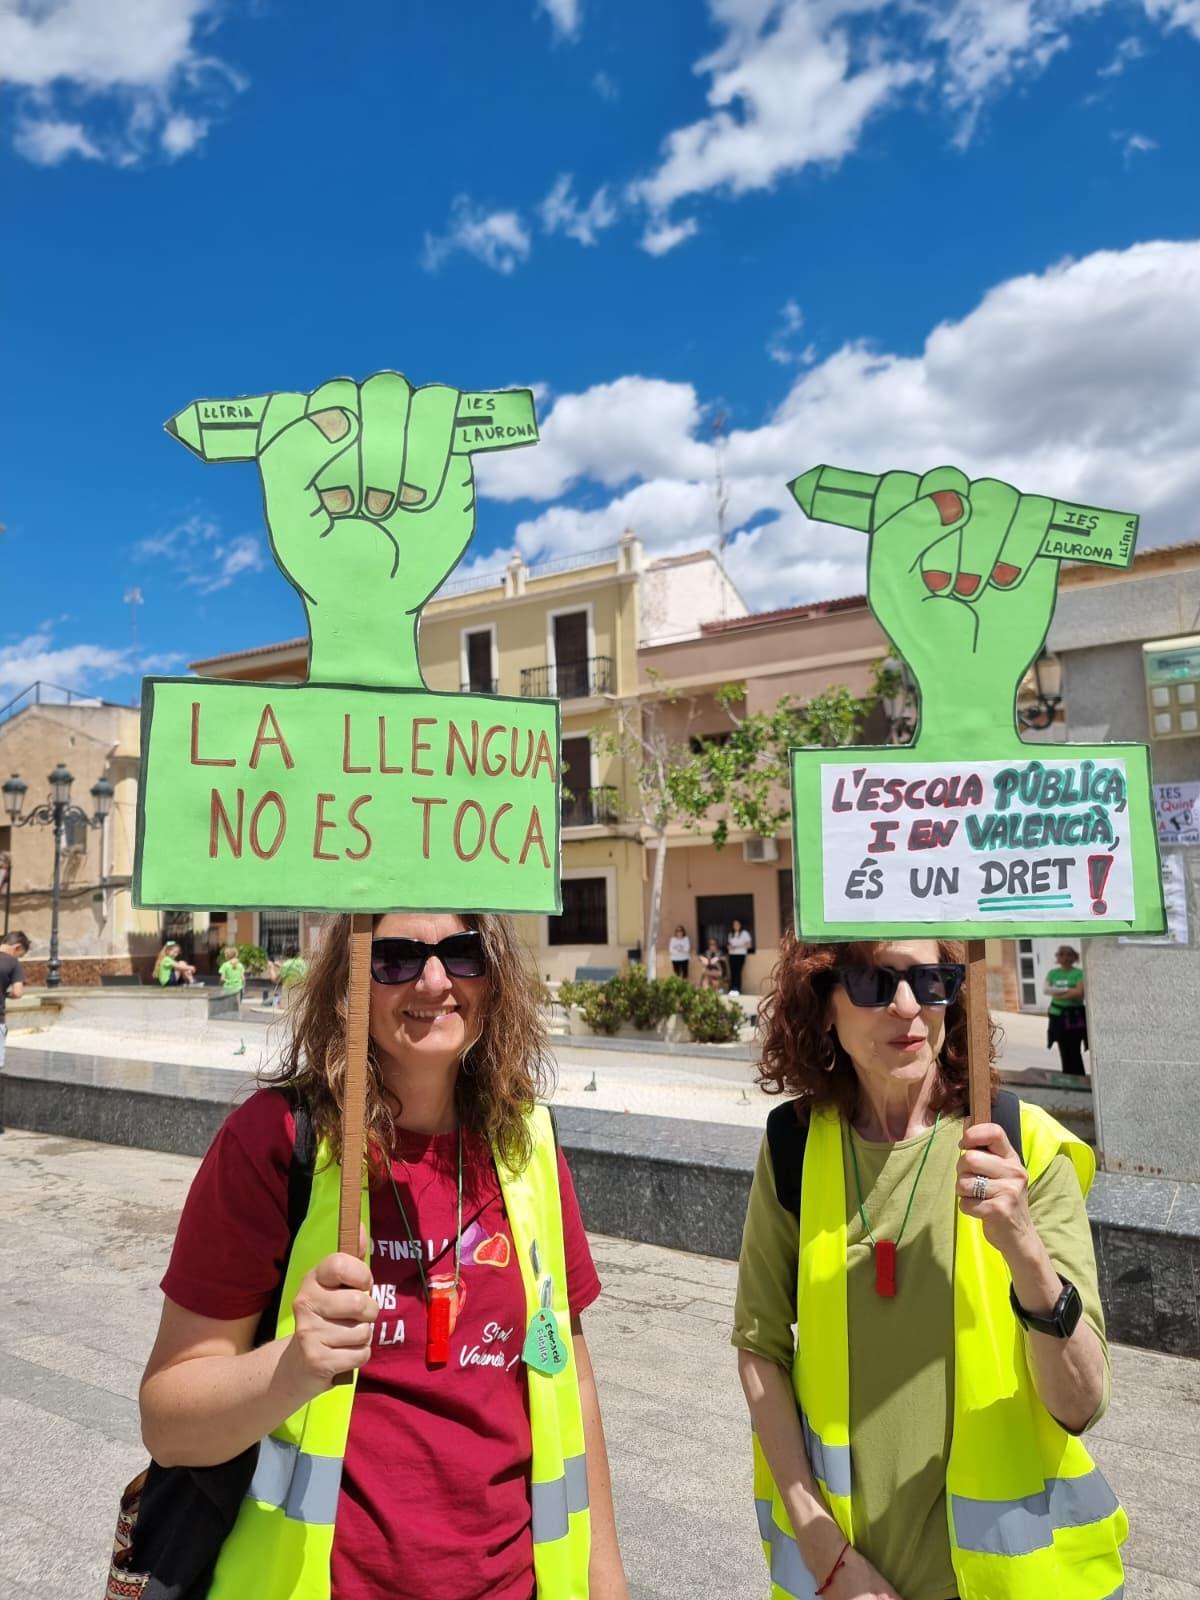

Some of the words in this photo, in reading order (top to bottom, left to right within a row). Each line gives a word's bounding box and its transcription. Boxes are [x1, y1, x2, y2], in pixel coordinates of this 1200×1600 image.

[467, 398, 496, 411] IES
[463, 424, 536, 442] LAURONA
[1063, 511, 1099, 530] IES
[1044, 540, 1113, 560] LAURONA
[190, 702, 295, 769] LA
[342, 713, 556, 783] LLENGUA
[832, 767, 983, 813] L'ESCOLA
[1159, 786, 1181, 800] IES
[209, 788, 288, 860] NO
[313, 794, 372, 860] ES
[412, 796, 551, 868] TOCA
[867, 820, 900, 853] I
[907, 818, 959, 851] EN
[845, 857, 884, 900] ÉS
[910, 867, 959, 898] UN
[379, 1319, 405, 1345] LA
